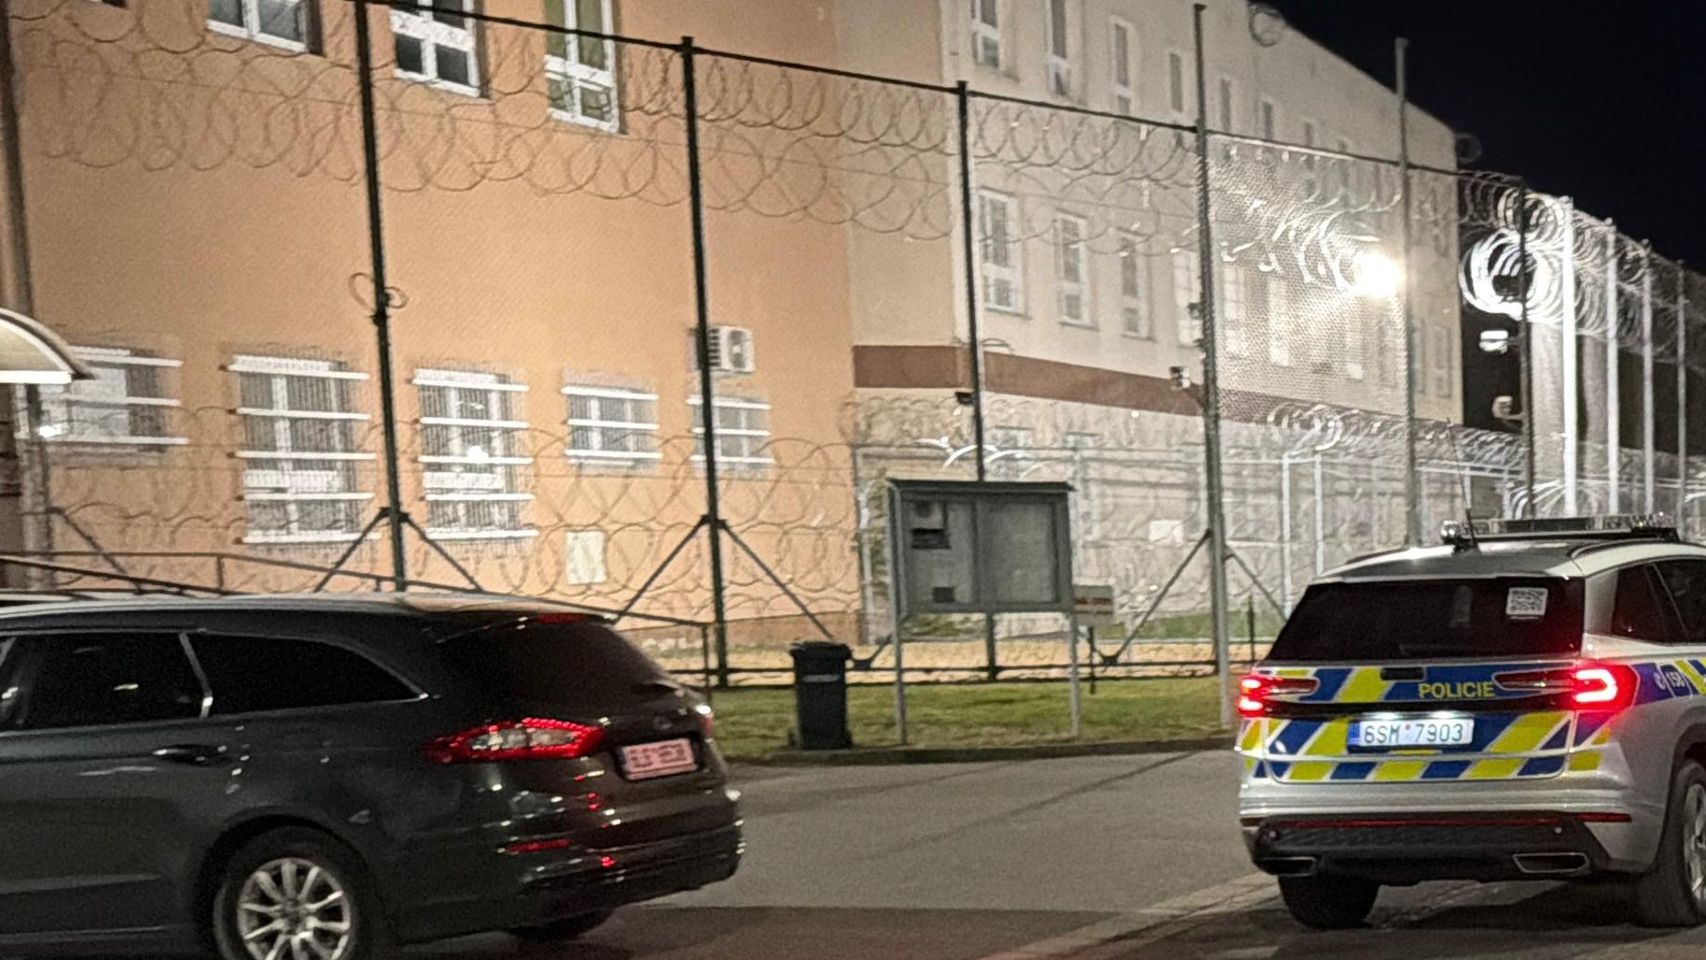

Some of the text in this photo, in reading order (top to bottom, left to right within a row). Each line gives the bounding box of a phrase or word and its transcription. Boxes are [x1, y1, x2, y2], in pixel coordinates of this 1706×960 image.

[1418, 681, 1496, 698] POLICIE
[1364, 723, 1463, 744] 6SM 7903
